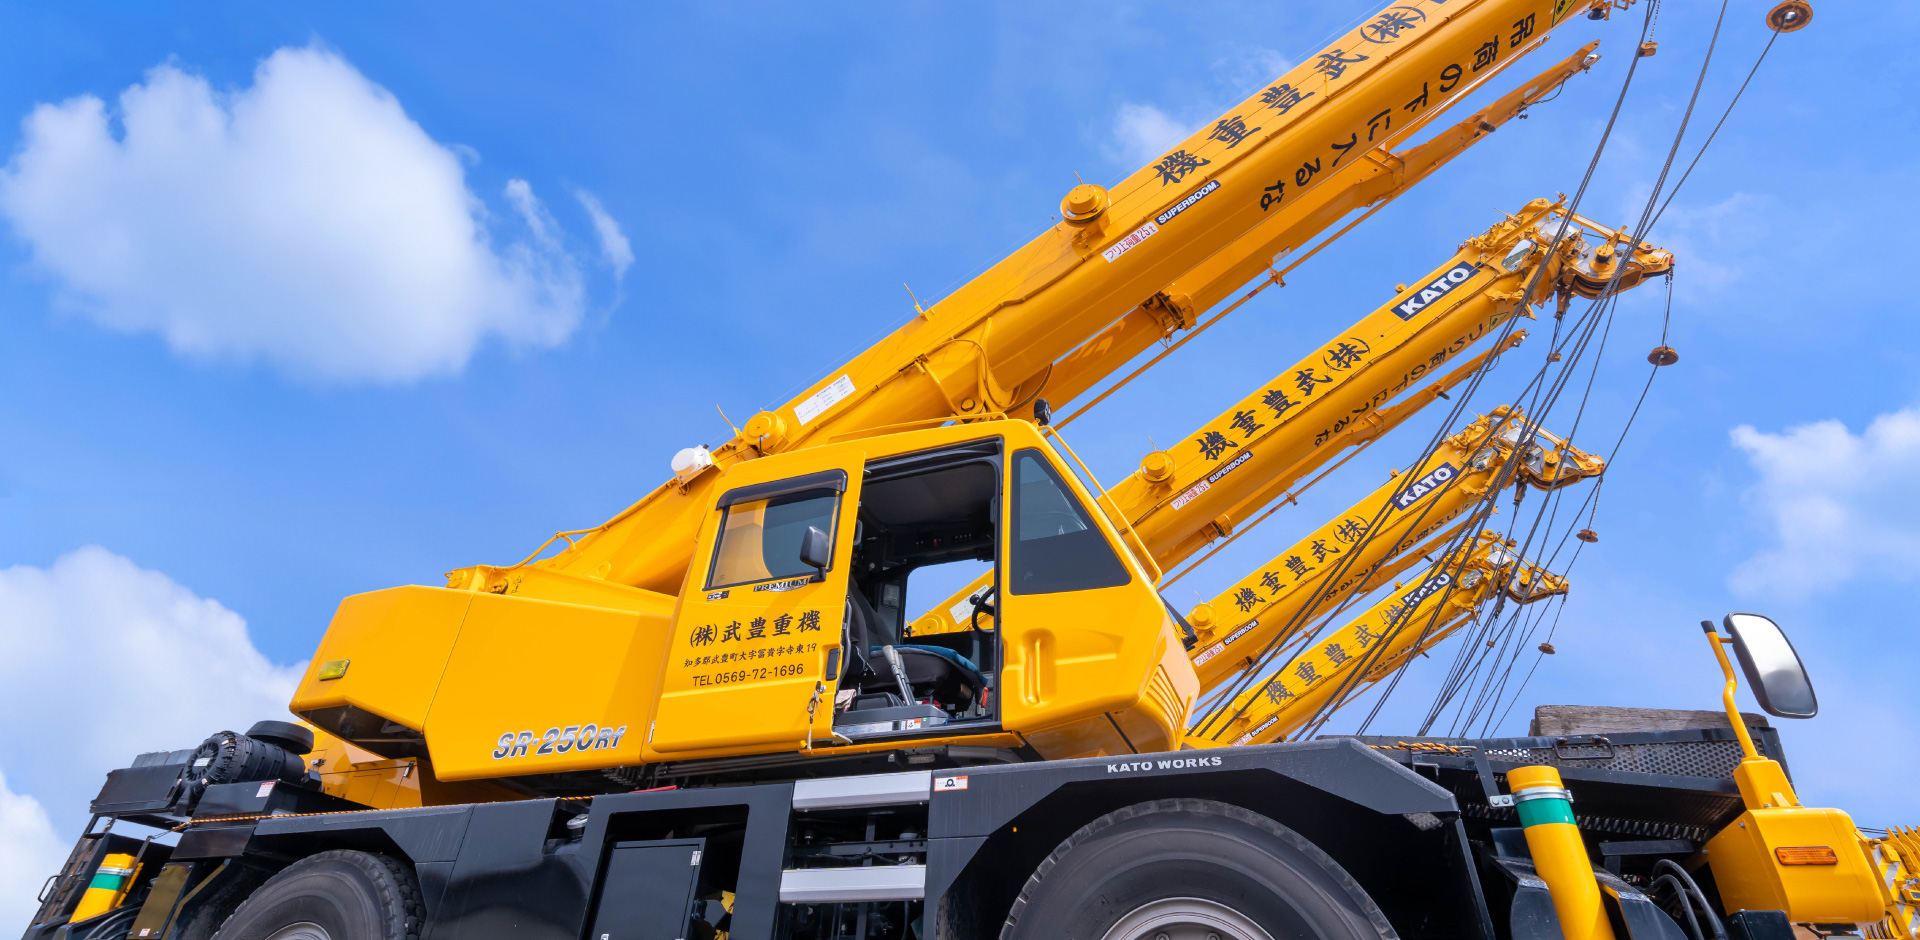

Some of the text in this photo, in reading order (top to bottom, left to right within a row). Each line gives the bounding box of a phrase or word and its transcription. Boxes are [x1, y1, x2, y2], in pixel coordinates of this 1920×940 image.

[1158, 181, 1217, 224] SUPERBOOM
[1400, 268, 1469, 315] KATO
[1209, 451, 1251, 483] SUPERBOOM
[1396, 467, 1451, 506] KATO
[754, 578, 808, 592] PREMIUM
[690, 609, 821, 648] (株)武豊重機
[1107, 756, 1222, 773] KATO WORKS
